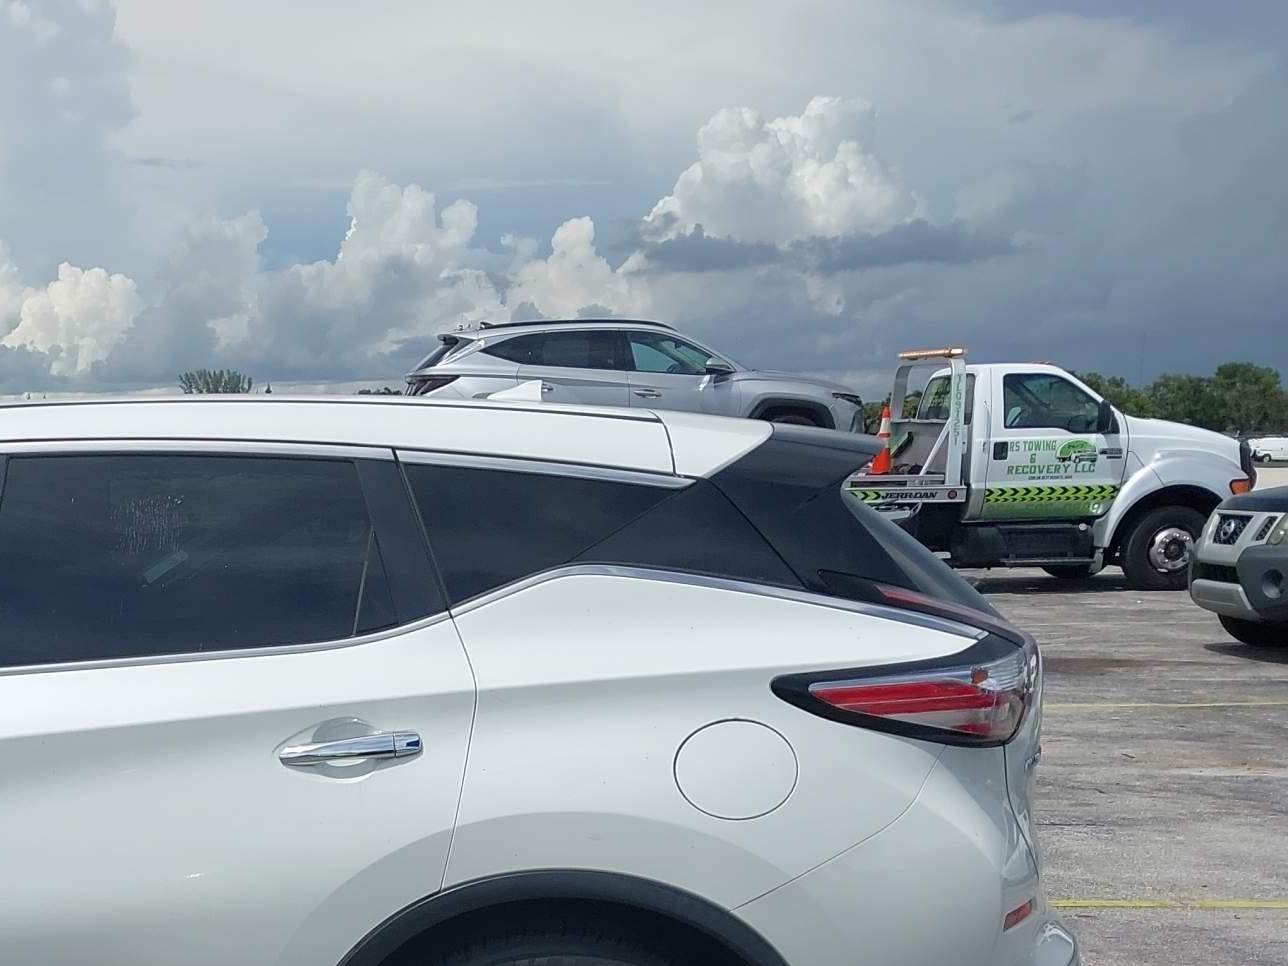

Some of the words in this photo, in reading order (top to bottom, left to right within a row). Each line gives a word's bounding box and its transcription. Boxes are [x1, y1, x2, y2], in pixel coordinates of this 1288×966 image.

[1010, 440, 1020, 452] RS
[1024, 440, 1056, 451] TOWING
[1007, 464, 1071, 475] RECOVERY
[1074, 463, 1096, 473] LLC
